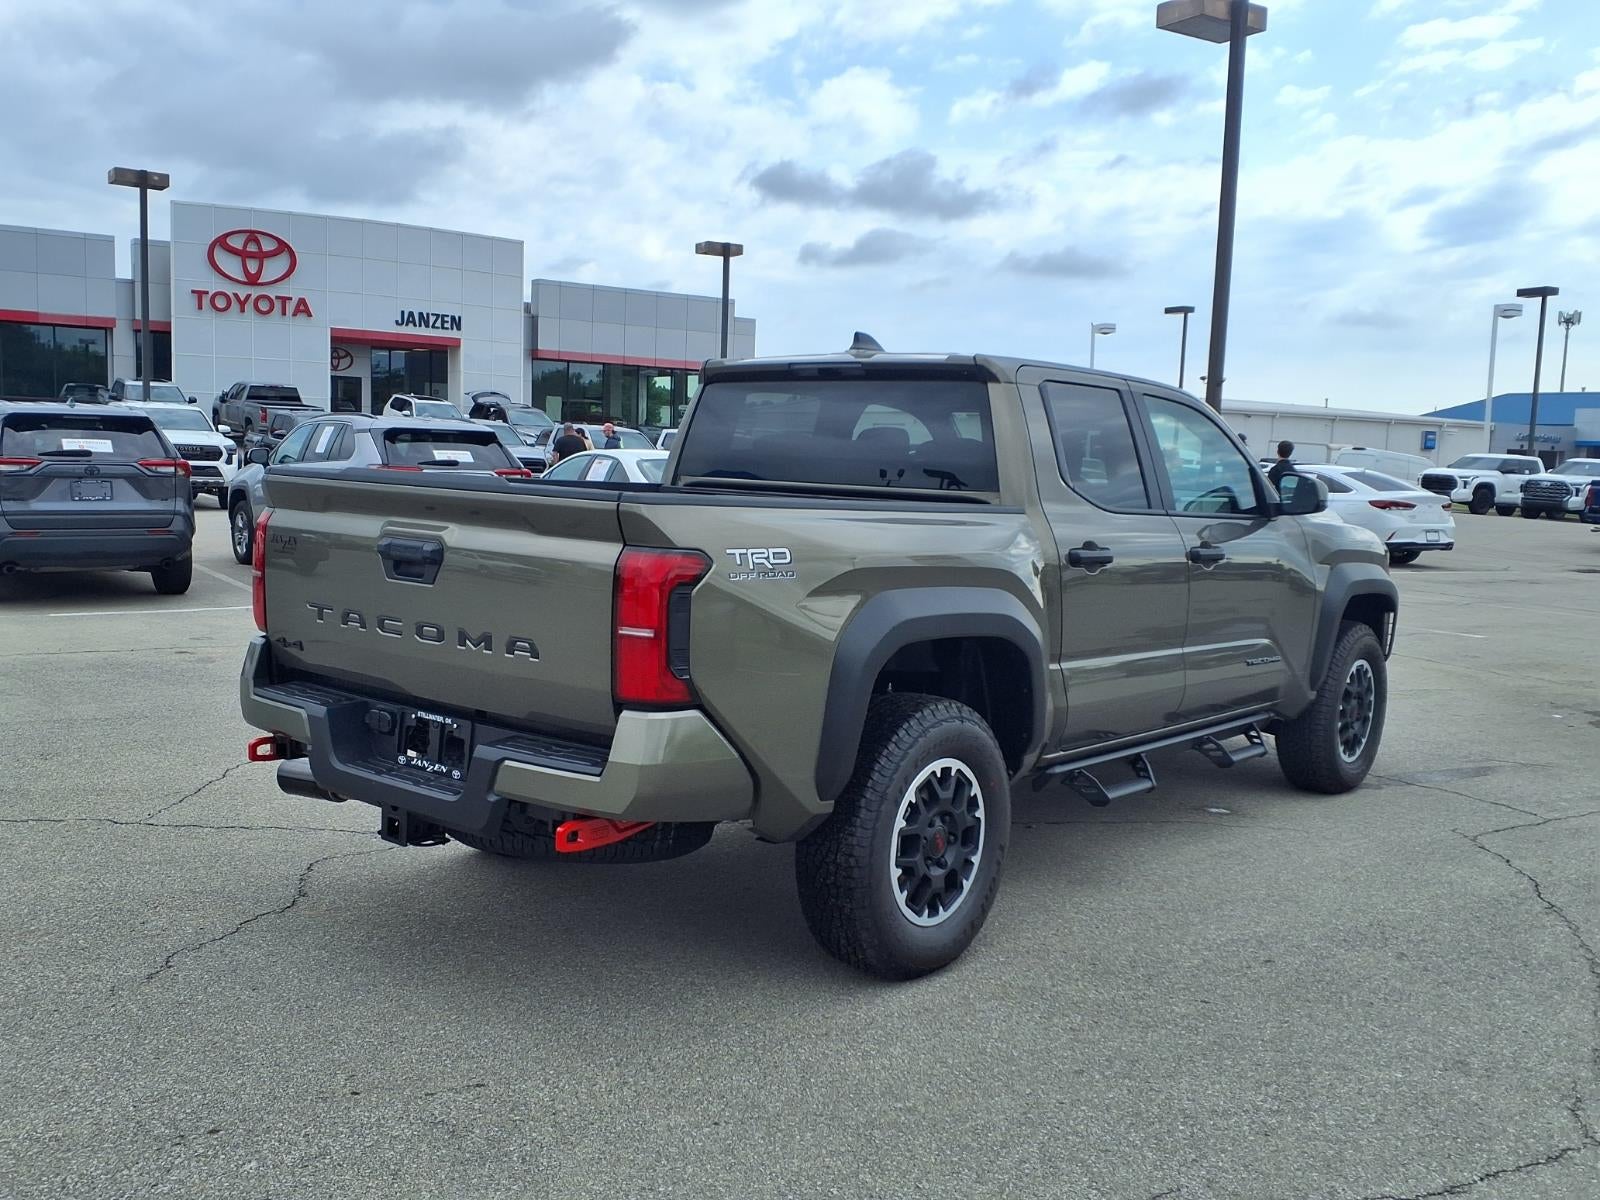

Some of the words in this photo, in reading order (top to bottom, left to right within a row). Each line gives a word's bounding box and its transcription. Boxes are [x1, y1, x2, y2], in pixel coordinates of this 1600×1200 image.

[191, 289, 313, 318] TOYOTA
[395, 310, 462, 331] JANZEN
[726, 547, 792, 570] TRD
[729, 572, 757, 581] OFF
[759, 571, 797, 580] ROAD
[306, 602, 540, 662] TACOMA
[445, 717, 452, 725] OK
[410, 758, 448, 773] JANZEN
